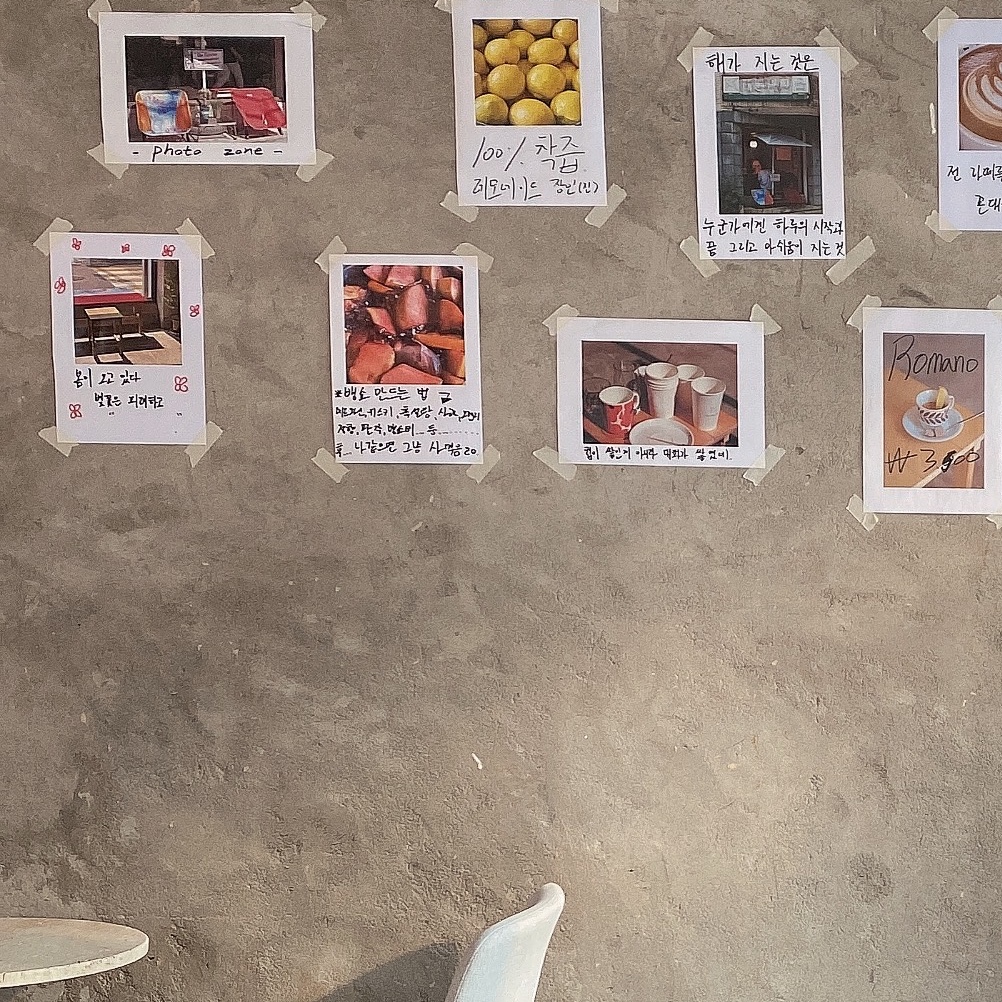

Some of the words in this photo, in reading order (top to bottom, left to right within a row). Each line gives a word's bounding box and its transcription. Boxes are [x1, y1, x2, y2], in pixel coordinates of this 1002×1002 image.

[705, 52, 741, 73] 해가
[755, 52, 784, 72] 지는
[790, 53, 820, 72] 것은
[152, 143, 202, 162] photo
[223, 146, 264, 157] zone
[535, 134, 586, 174] 착즙
[947, 165, 962, 181] 전
[772, 217, 808, 236] 하루의
[729, 239, 758, 254] 그리고
[810, 239, 831, 256] 지는
[835, 241, 846, 256] 것
[887, 334, 979, 381] Romano
[73, 368, 93, 389] 봄이
[98, 372, 115, 385] 오고
[119, 370, 142, 386] 있다
[374, 387, 411, 401] 만드는
[416, 388, 430, 401] 법
[402, 441, 422, 453] 그냥
